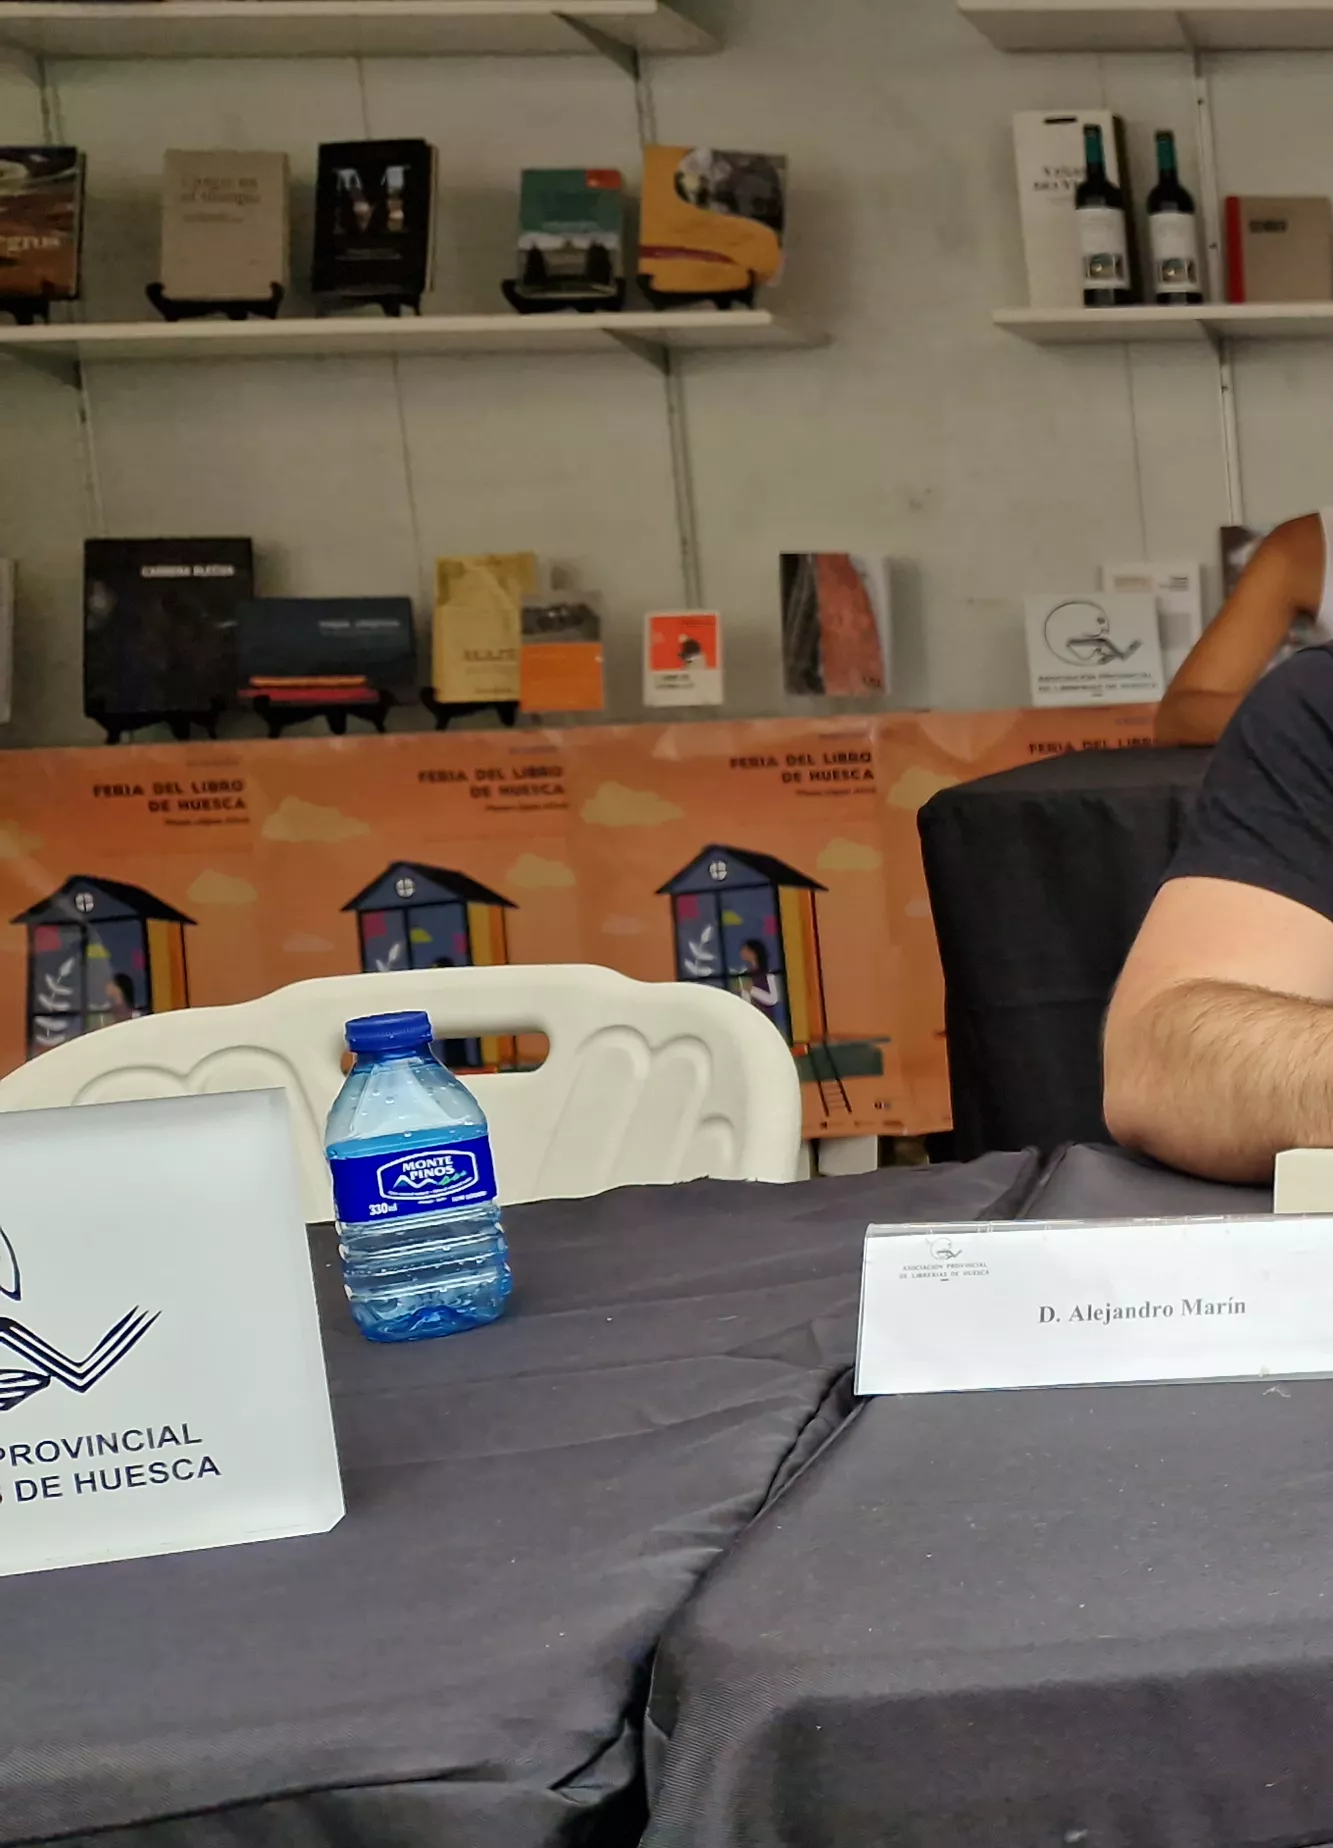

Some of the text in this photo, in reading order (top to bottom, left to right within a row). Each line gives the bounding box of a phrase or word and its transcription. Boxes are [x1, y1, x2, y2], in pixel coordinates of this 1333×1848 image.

[786, 754, 816, 766] DEL
[782, 769, 875, 783] DE HUESCA
[93, 779, 245, 797] FERIA DEL LIBRO
[148, 797, 247, 812] DE HUESCA
[402, 1155, 454, 1173] MONTE
[409, 1164, 456, 1181] PINOS
[1038, 1296, 1247, 1326] D. Alejandro Marín
[0, 1422, 203, 1468] ROVINCIAL
[15, 1475, 63, 1504] DE
[73, 1456, 222, 1495] HUESCA
